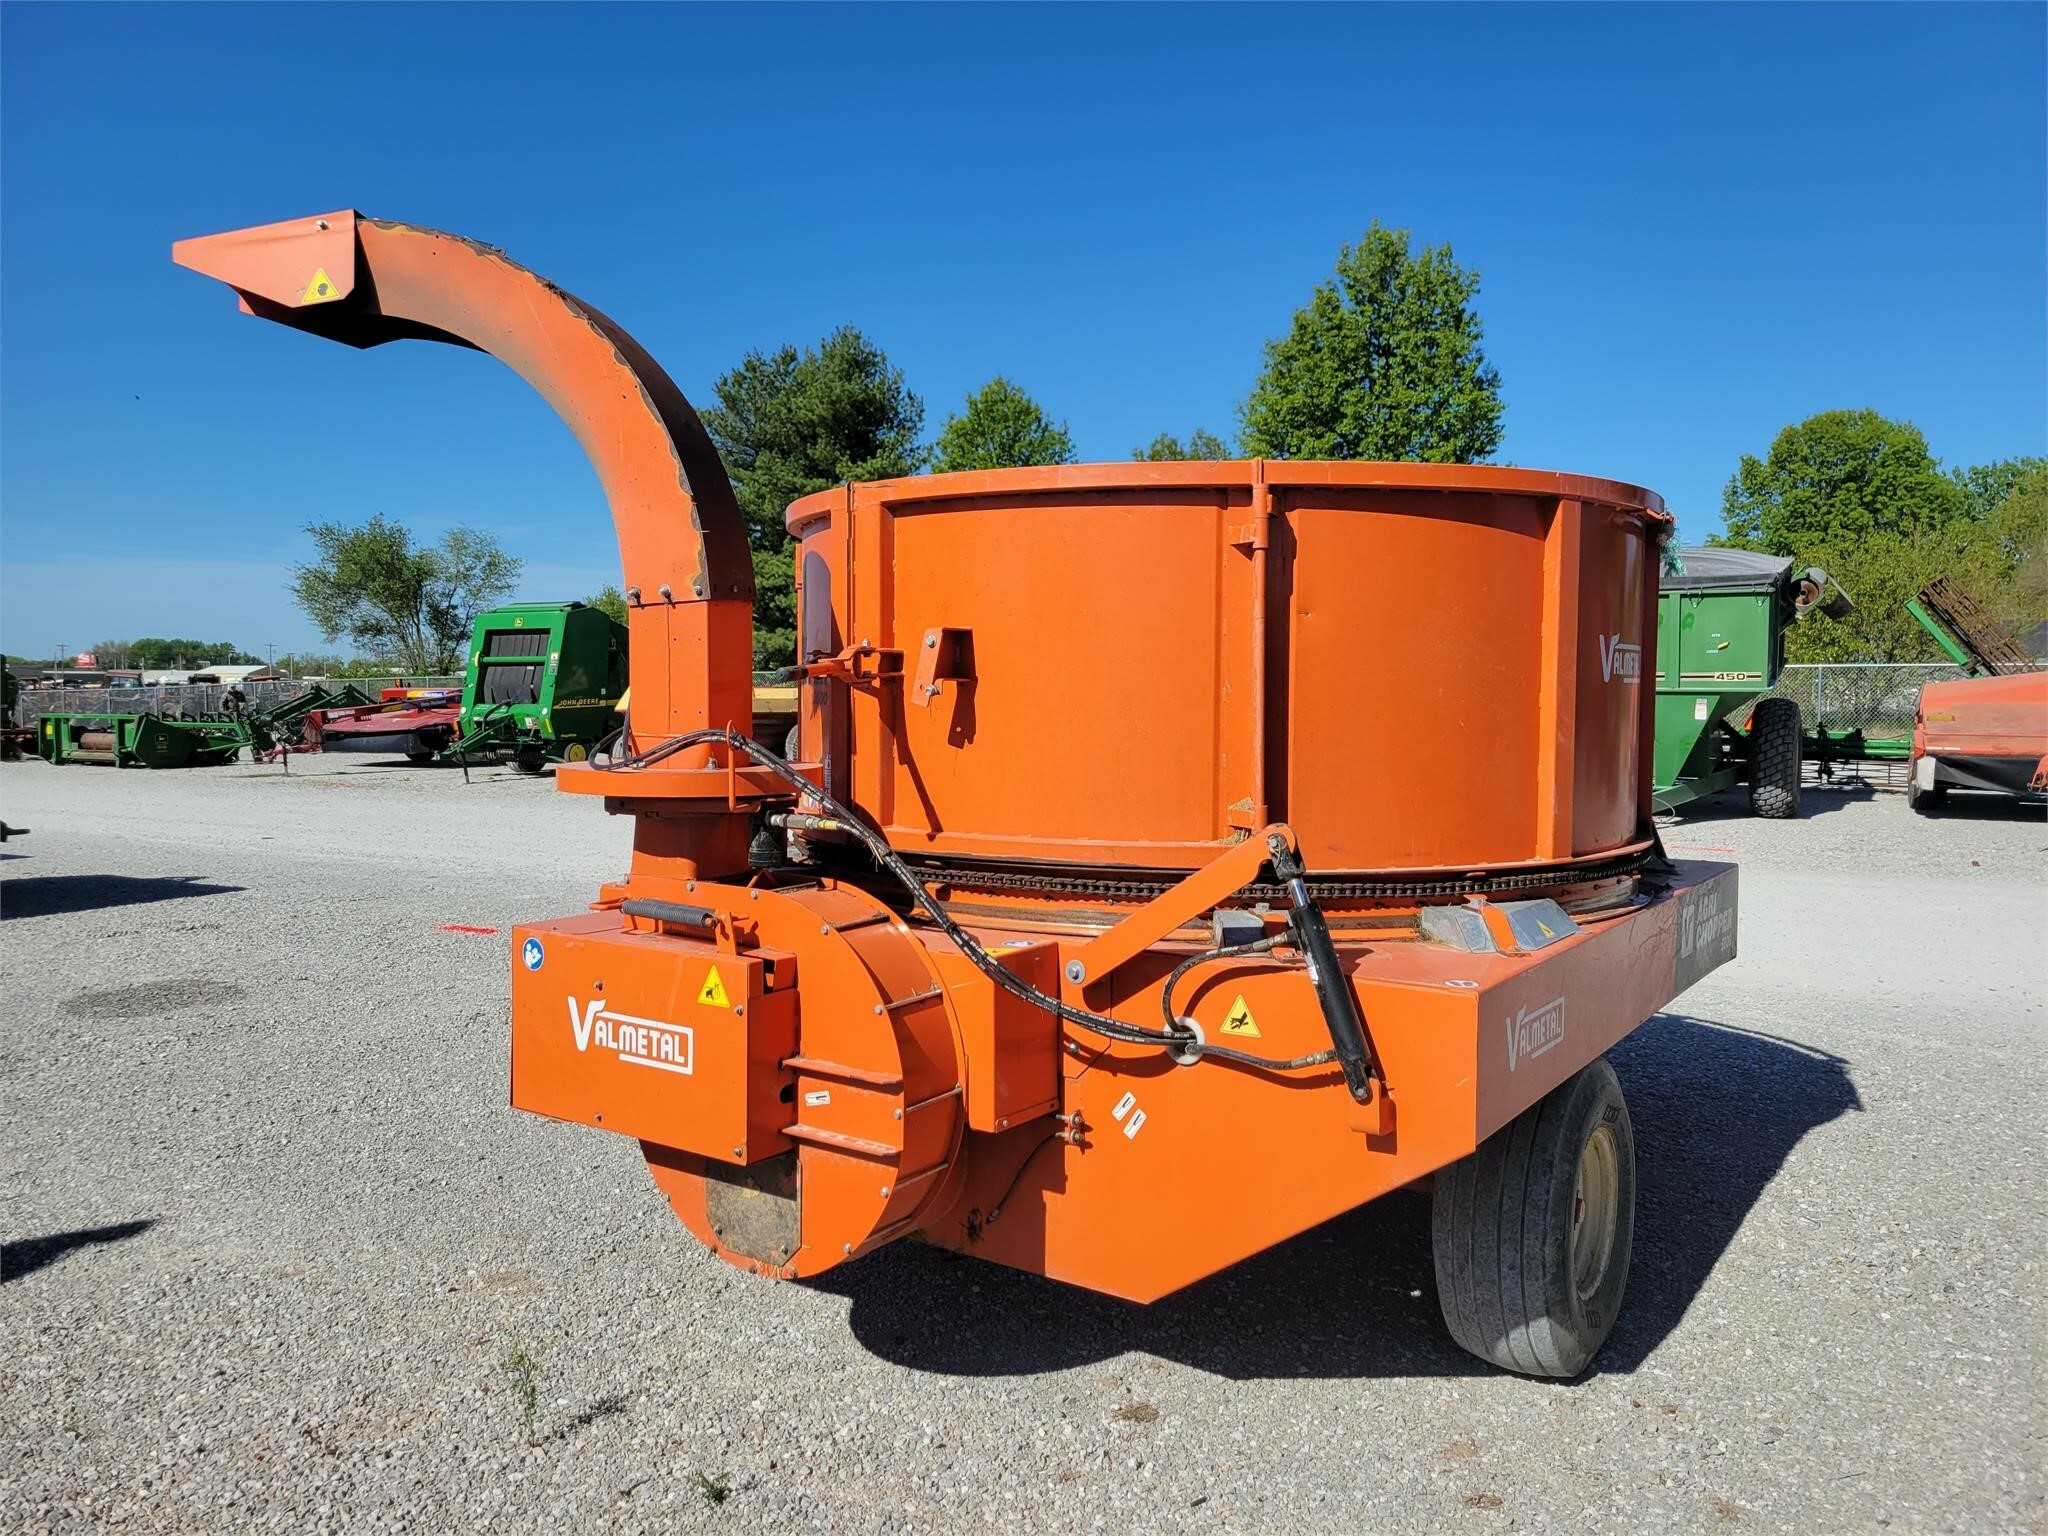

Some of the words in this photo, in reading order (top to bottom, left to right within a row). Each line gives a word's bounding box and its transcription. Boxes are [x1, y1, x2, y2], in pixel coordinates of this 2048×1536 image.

[1716, 673, 1746, 681] 450
[1696, 907, 1734, 948] CHOPPER
[1697, 892, 1718, 923] AGRI
[567, 995, 686, 1064] VALMETAL
[1505, 1004, 1561, 1072] VALMETAL
